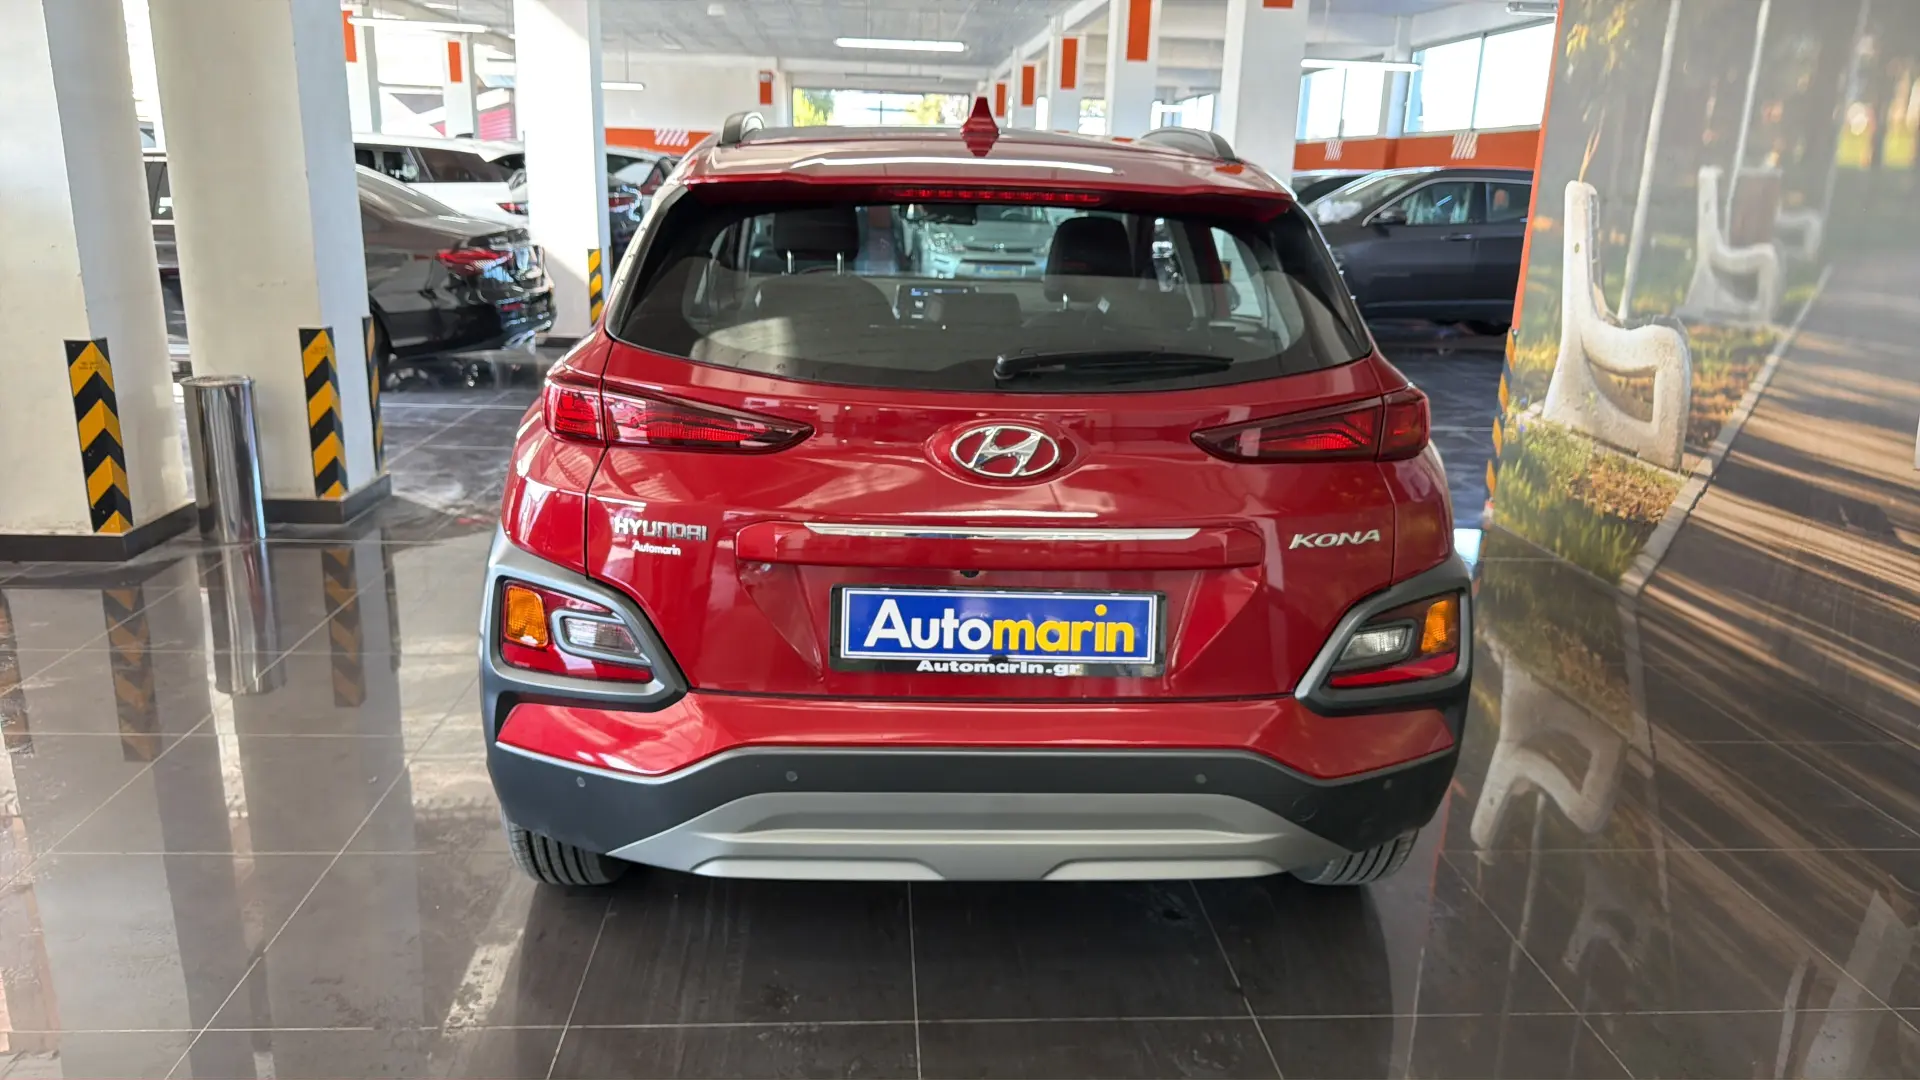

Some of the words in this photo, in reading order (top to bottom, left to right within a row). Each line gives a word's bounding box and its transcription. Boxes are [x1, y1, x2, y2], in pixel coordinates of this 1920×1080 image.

[613, 516, 708, 542] HYUNDAI
[1288, 529, 1380, 550] KONA
[632, 540, 681, 556] Automarin
[863, 599, 1135, 652] Automarin
[916, 660, 1080, 676] Automarin.gr
